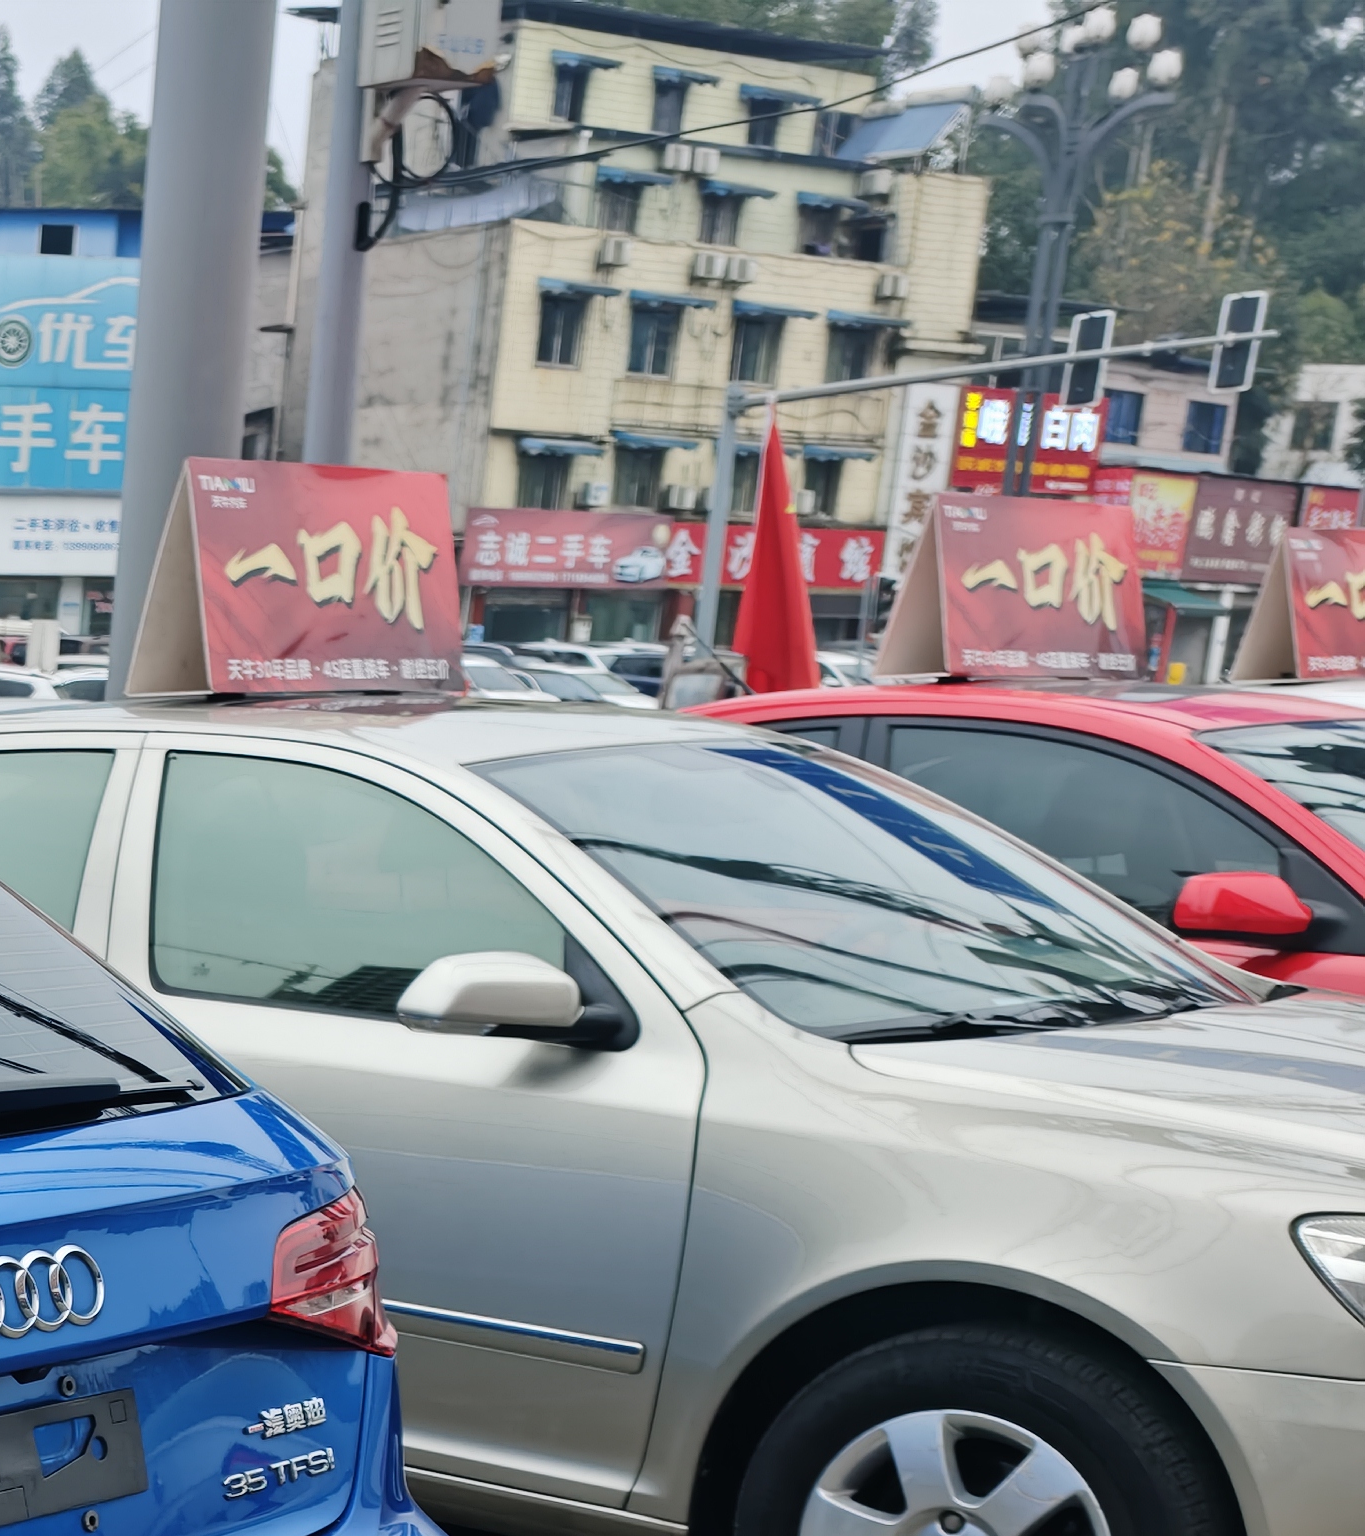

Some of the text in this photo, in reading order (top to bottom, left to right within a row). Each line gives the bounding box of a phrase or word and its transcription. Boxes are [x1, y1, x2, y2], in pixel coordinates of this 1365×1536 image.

[224, 506, 439, 634] 一口价
[961, 531, 1129, 633] 一口价
[246, 1396, 327, 1438] 一汽奥迪
[222, 1447, 336, 1500] 35 TFSI
